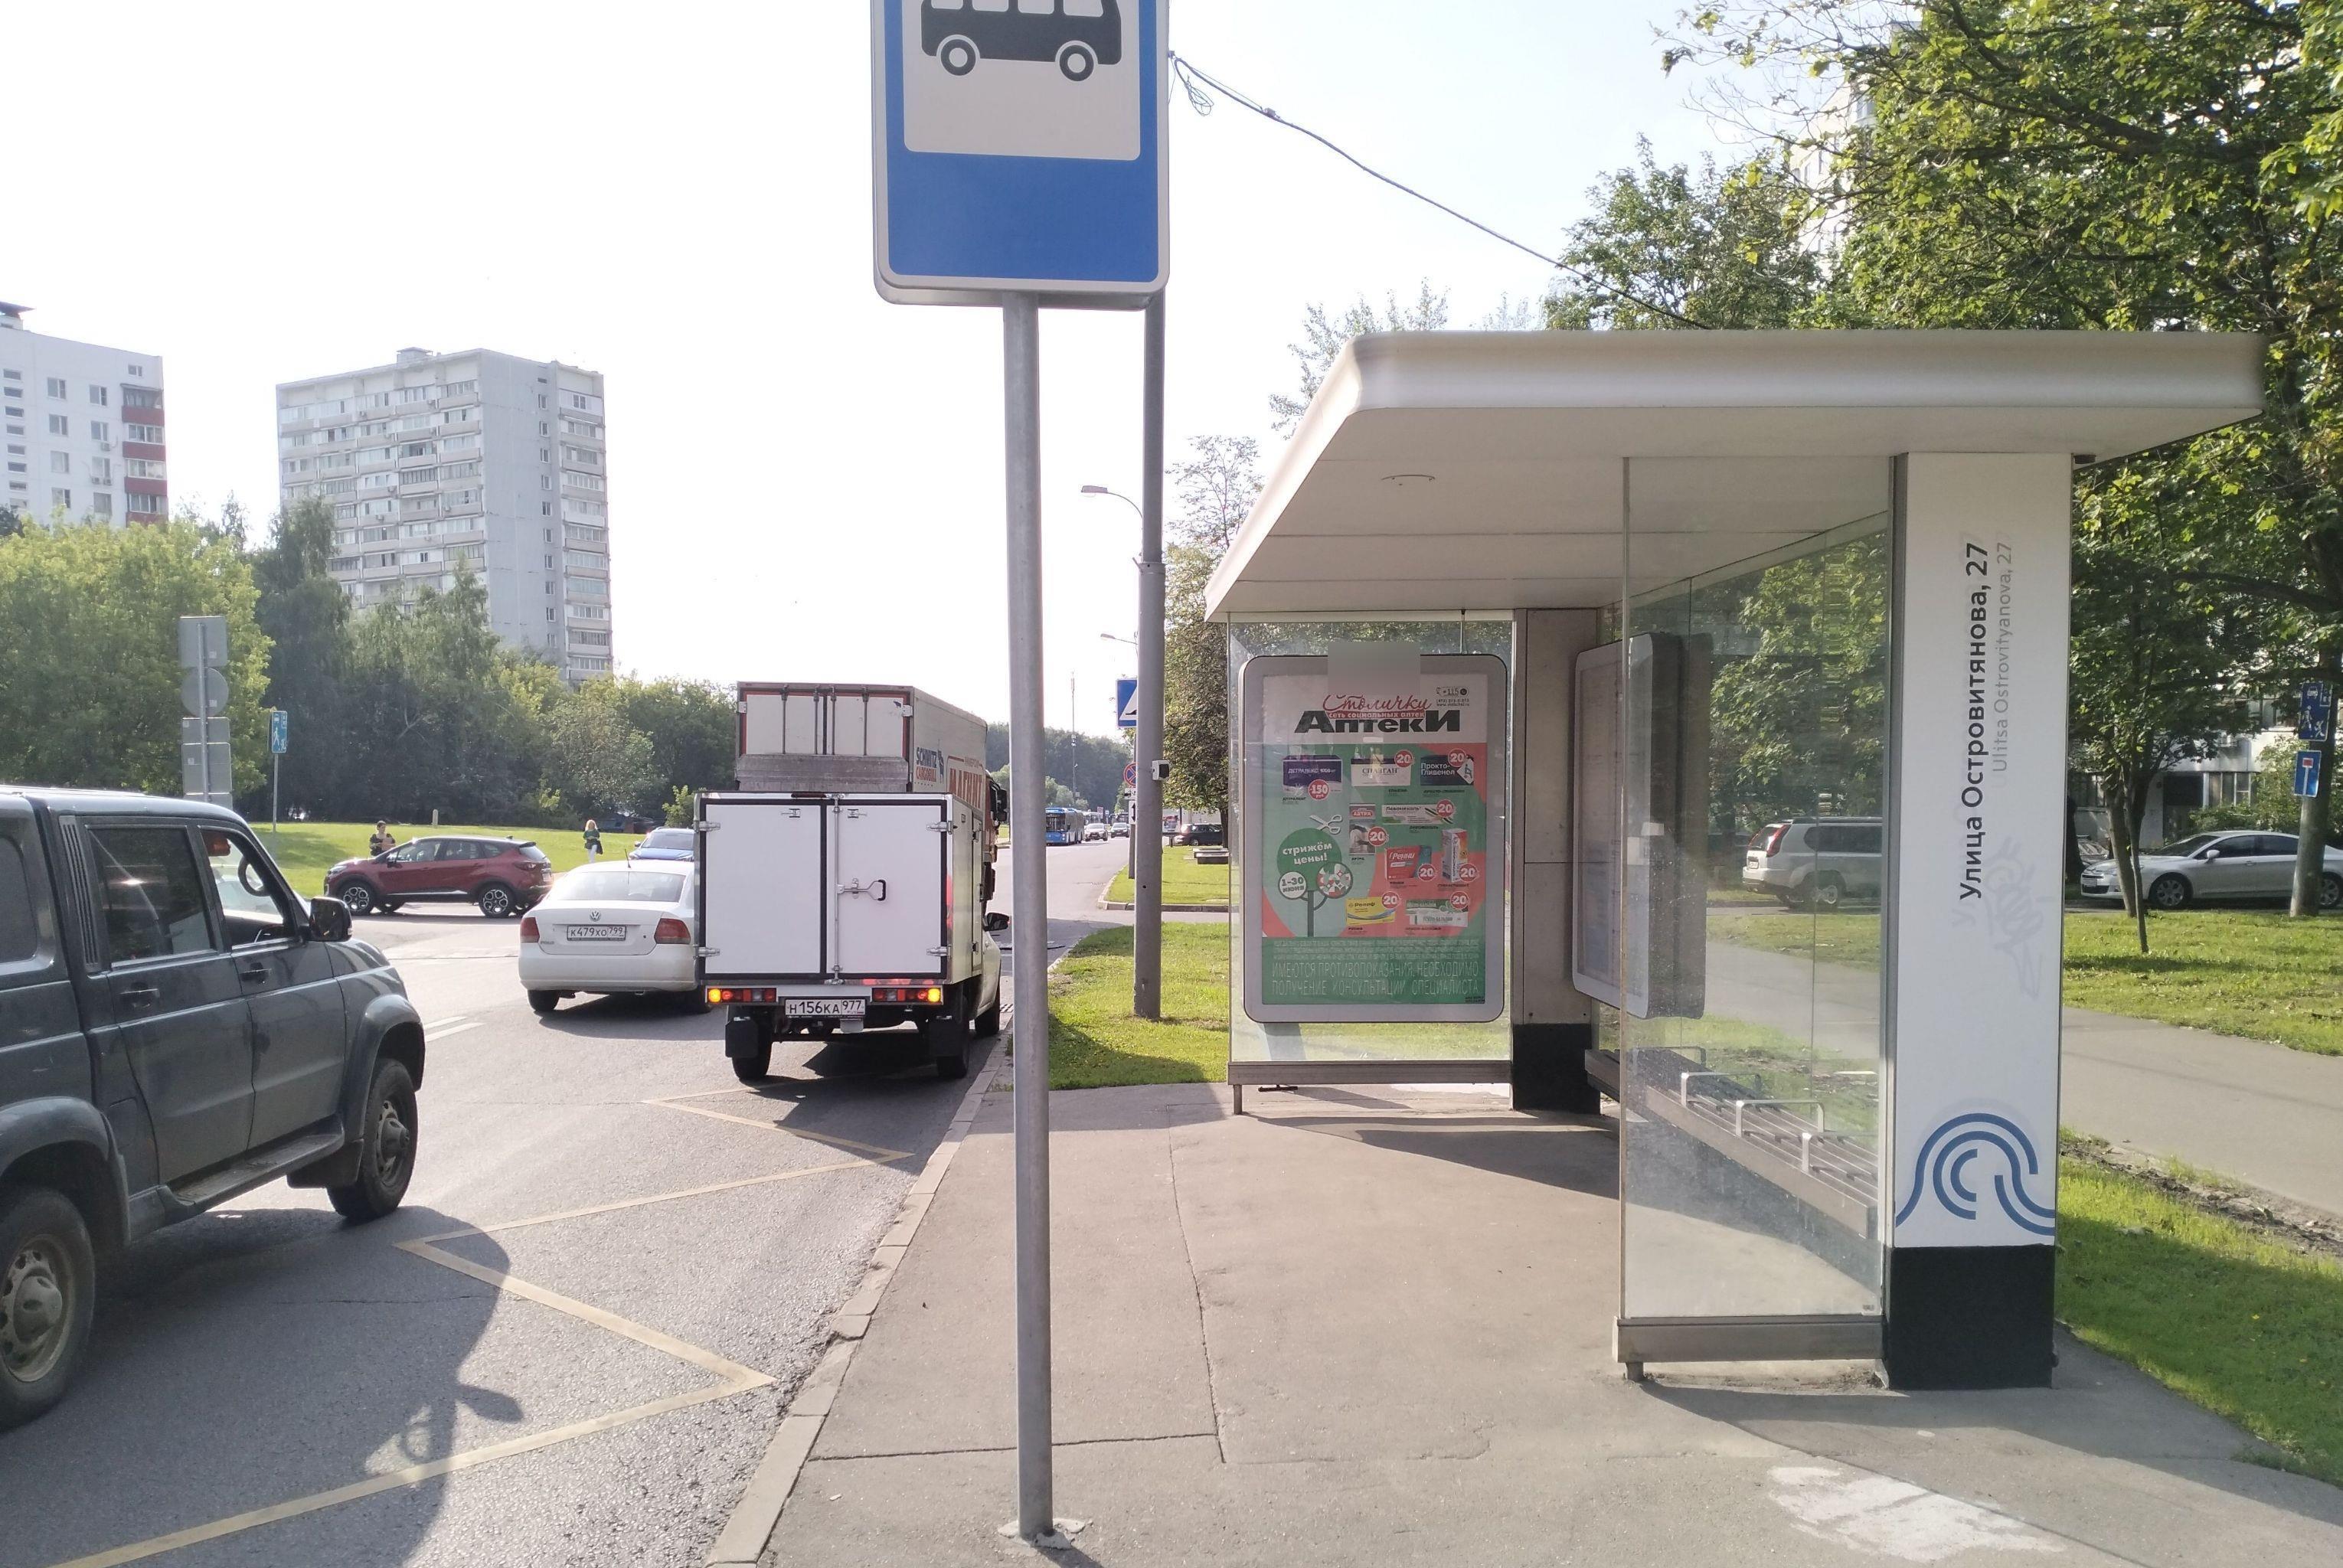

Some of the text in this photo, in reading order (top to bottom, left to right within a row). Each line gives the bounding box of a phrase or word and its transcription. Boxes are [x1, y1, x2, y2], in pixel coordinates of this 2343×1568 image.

[1992, 542, 2014, 772] Ulitsa Ostrovityanova, 27
[1959, 542, 1992, 900] Улица Островитянова, 27
[1282, 841, 1332, 857] стрижём
[1293, 852, 1328, 865] цены!
[1282, 877, 1304, 887] 1-30
[609, 926, 623, 935] 799
[1272, 962, 1316, 978] ИМЕЮТСЯ
[1417, 961, 1479, 977] НЕОБХОДИМО
[1272, 979, 1479, 996] ПОЛУЧЕНИЕ КОНСУЛЬТАЦИИ СПЕЦИАЛИСТА
[842, 1000, 862, 1011] 977
